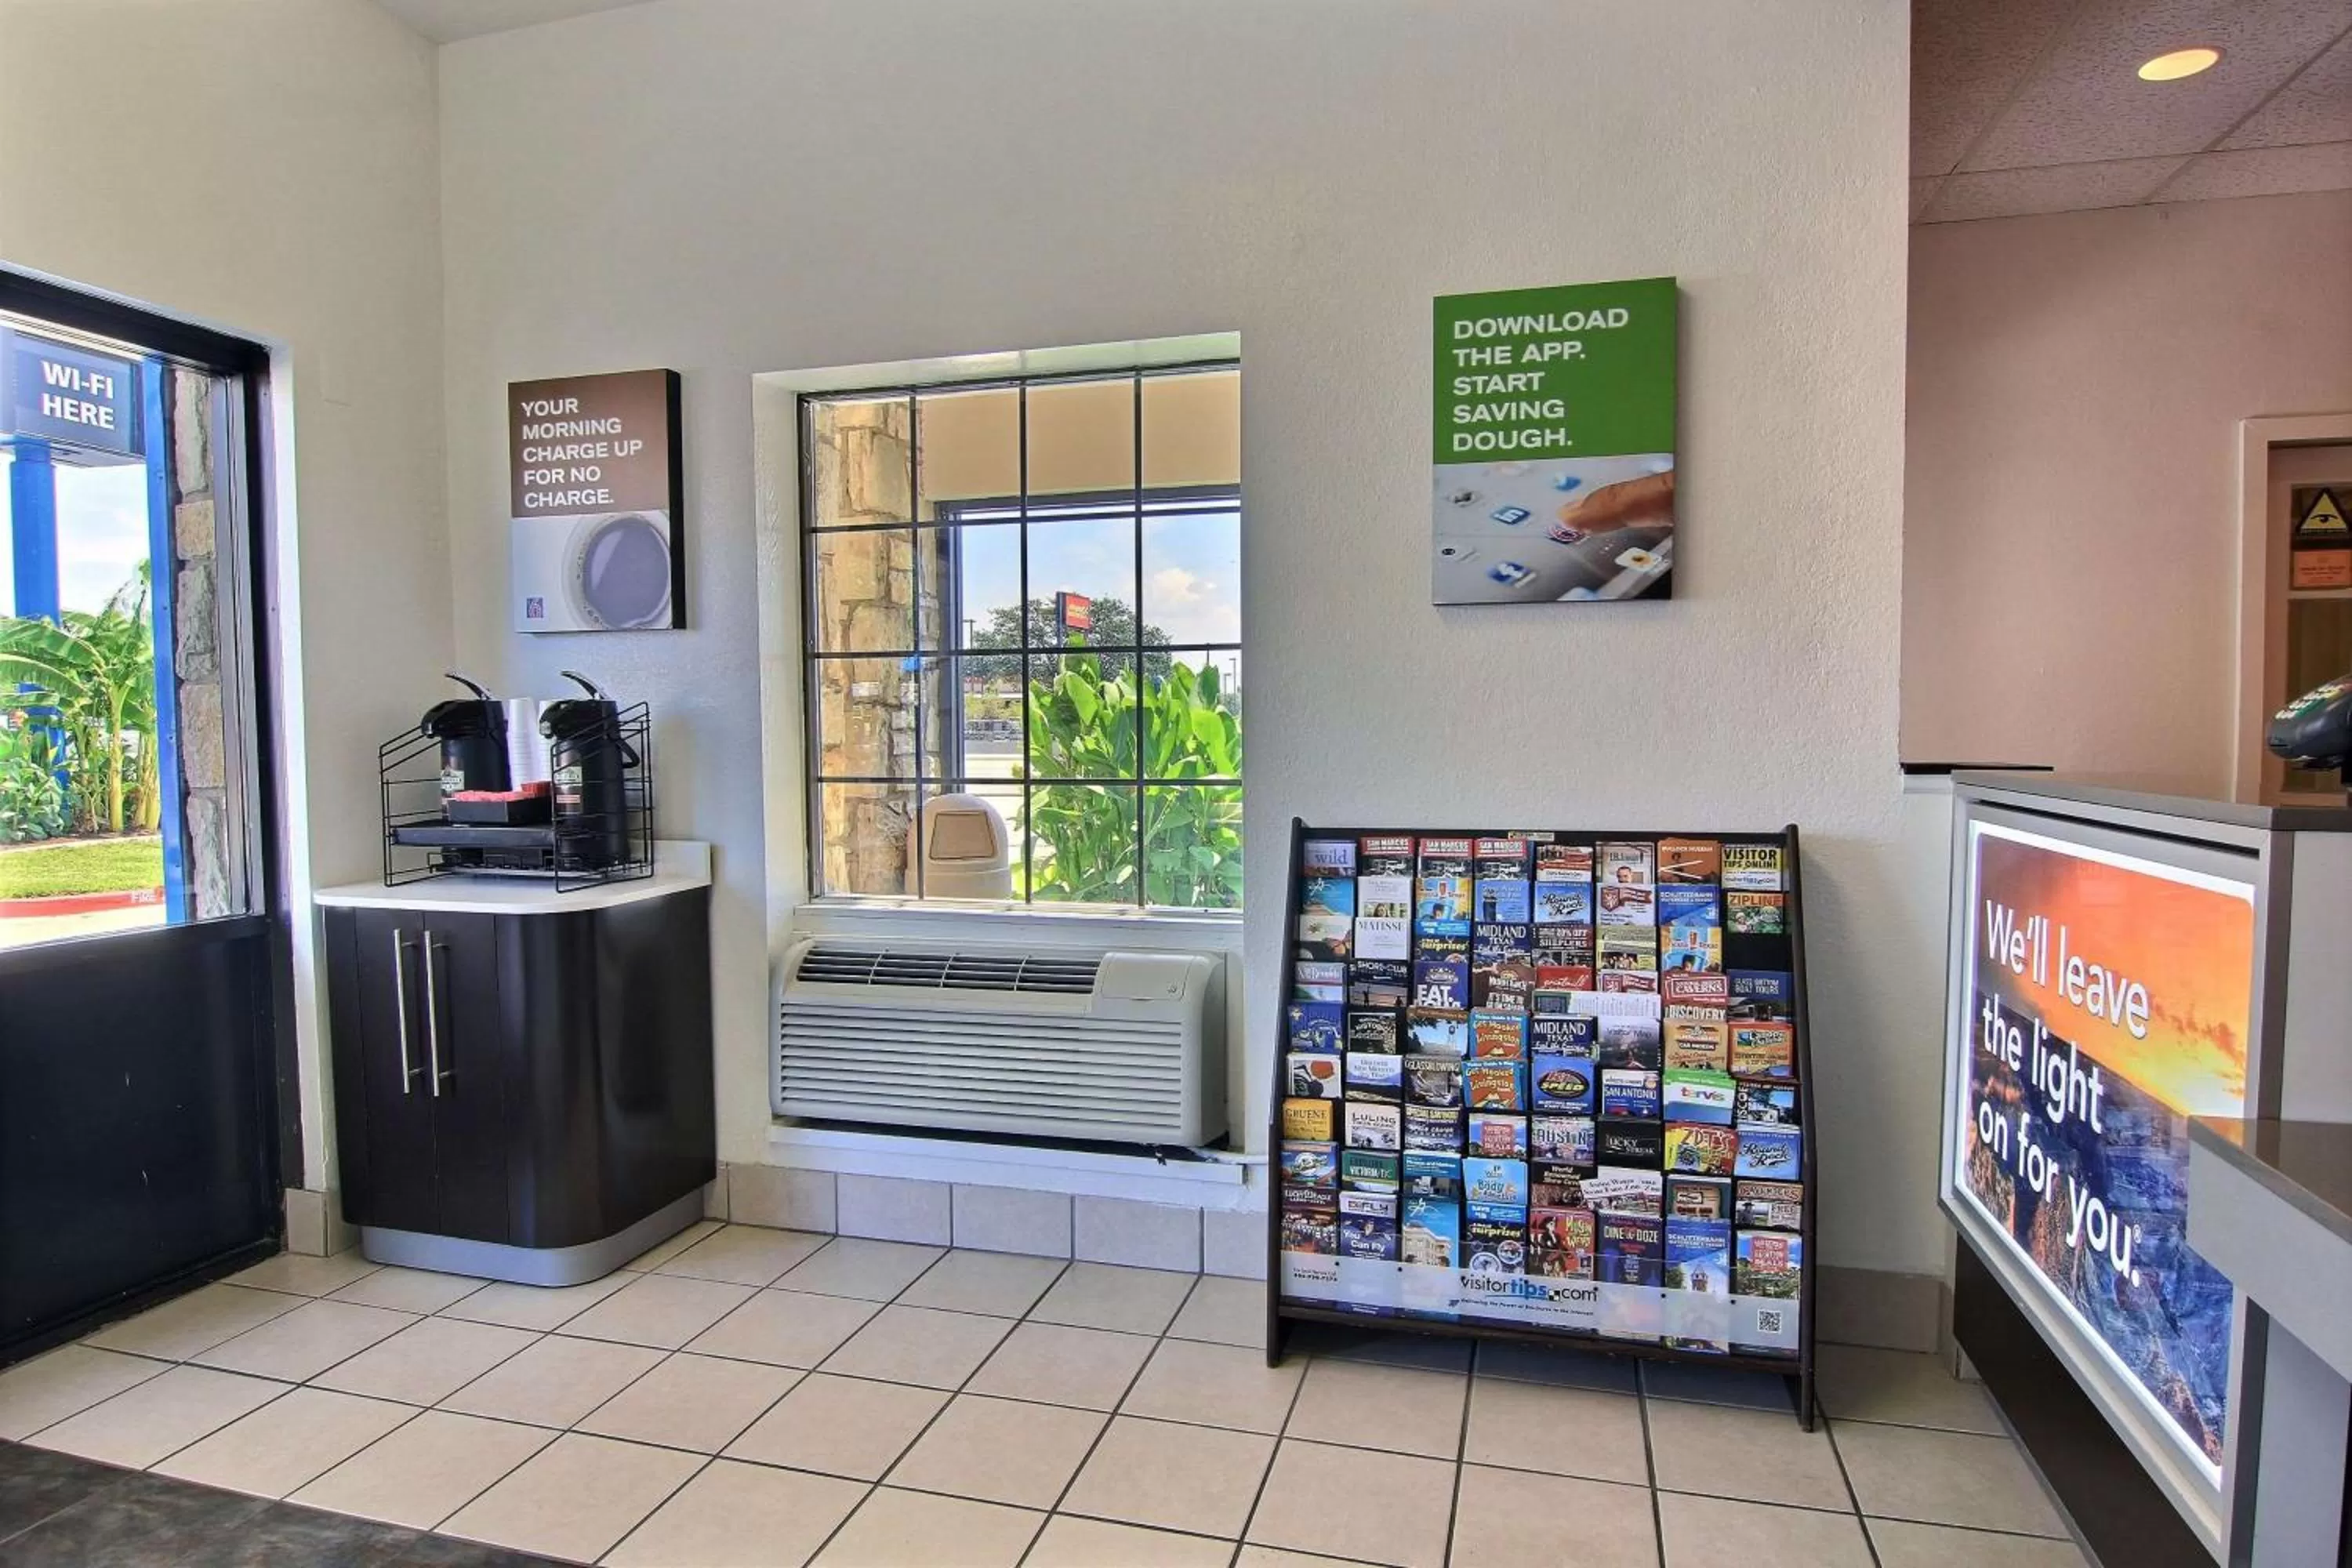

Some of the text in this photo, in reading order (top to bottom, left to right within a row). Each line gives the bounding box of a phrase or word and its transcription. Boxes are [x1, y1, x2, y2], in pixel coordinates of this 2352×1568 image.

[1454, 308, 1628, 339] DOWNLOAD
[1452, 340, 1586, 367] THE APP.
[42, 360, 114, 399] WI-FI
[1453, 372, 1545, 396] START
[42, 392, 115, 430] HERE
[521, 397, 579, 416] YOUR
[1452, 399, 1565, 424] SAVING
[522, 417, 622, 440] MORNING
[1453, 427, 1573, 452] DOUGH.
[523, 440, 643, 462] CHARGE UP
[523, 466, 601, 485] FOR NO
[524, 488, 615, 508] CHARGE.
[1315, 849, 1348, 865] wild
[1725, 849, 1777, 861] VISITOR
[1730, 895, 1782, 906] ZIPLINE
[1476, 924, 1526, 938] MIDLAND
[1986, 898, 2150, 1040] We'll leave
[1669, 1004, 1726, 1020] DISCOVERY
[1533, 1022, 1586, 1035] MIDLAND
[1983, 993, 2105, 1134] the light
[1541, 1082, 1584, 1091] SPEED
[1604, 1086, 1657, 1099] SAN ANTONIO
[1285, 1109, 1327, 1119] GRUENE
[1352, 1112, 1396, 1125] LULING
[1537, 1128, 1587, 1145] AUSTIN
[1607, 1137, 1638, 1147] LUCKY
[1625, 1146, 1656, 1156] STREAK
[1743, 1142, 1787, 1156] Round
[1979, 1100, 2009, 1161] on
[2017, 1116, 2059, 1203] for
[1749, 1152, 1791, 1167] Rock
[1343, 1229, 1360, 1240] You
[1604, 1225, 1624, 1240] DINE
[1636, 1229, 1658, 1243] DOZE
[1351, 1240, 1386, 1253] Can Fly
[1461, 1274, 1596, 1301] visitortips.com
